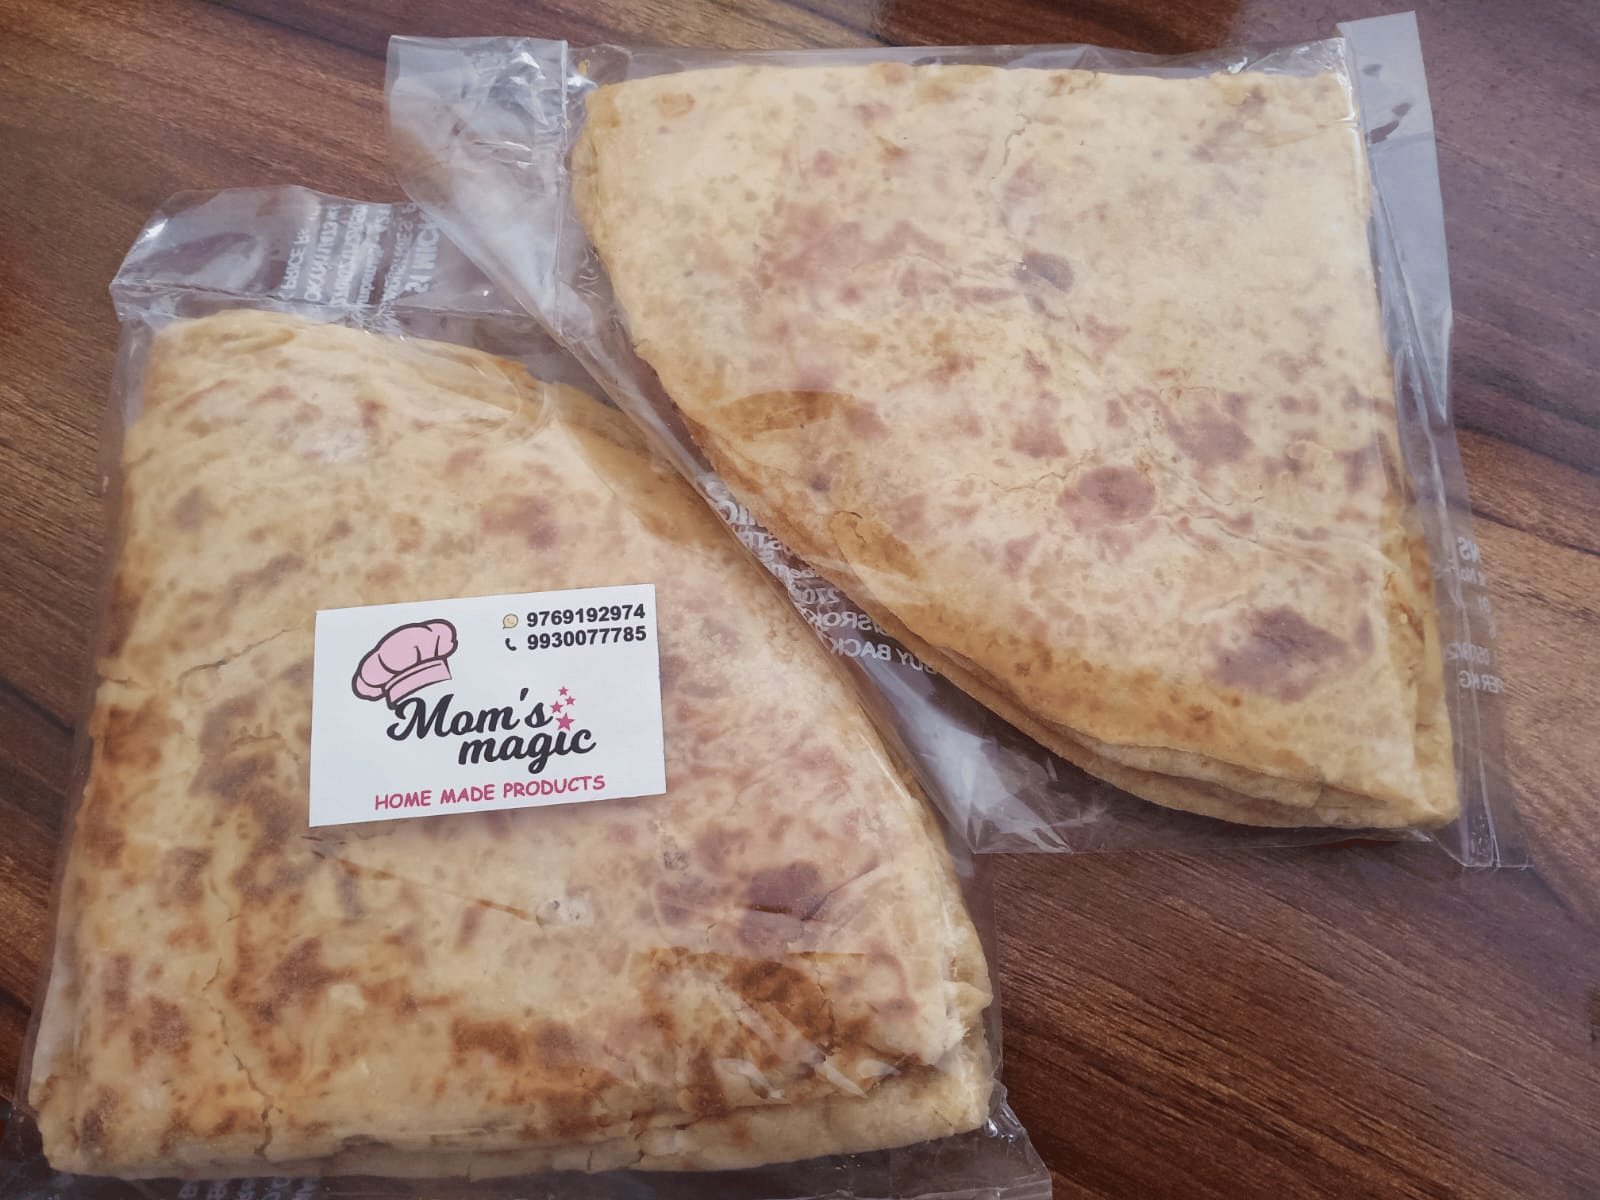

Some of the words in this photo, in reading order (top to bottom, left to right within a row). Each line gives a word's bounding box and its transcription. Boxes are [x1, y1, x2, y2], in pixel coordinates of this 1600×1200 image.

[526, 603, 646, 628] 9769192974
[527, 625, 647, 650] 9930077785
[386, 687, 554, 742] Mom's
[457, 728, 597, 775] magic
[374, 789, 432, 811] HOME
[440, 783, 496, 805] MADE
[503, 774, 606, 799] PRODUCTS
